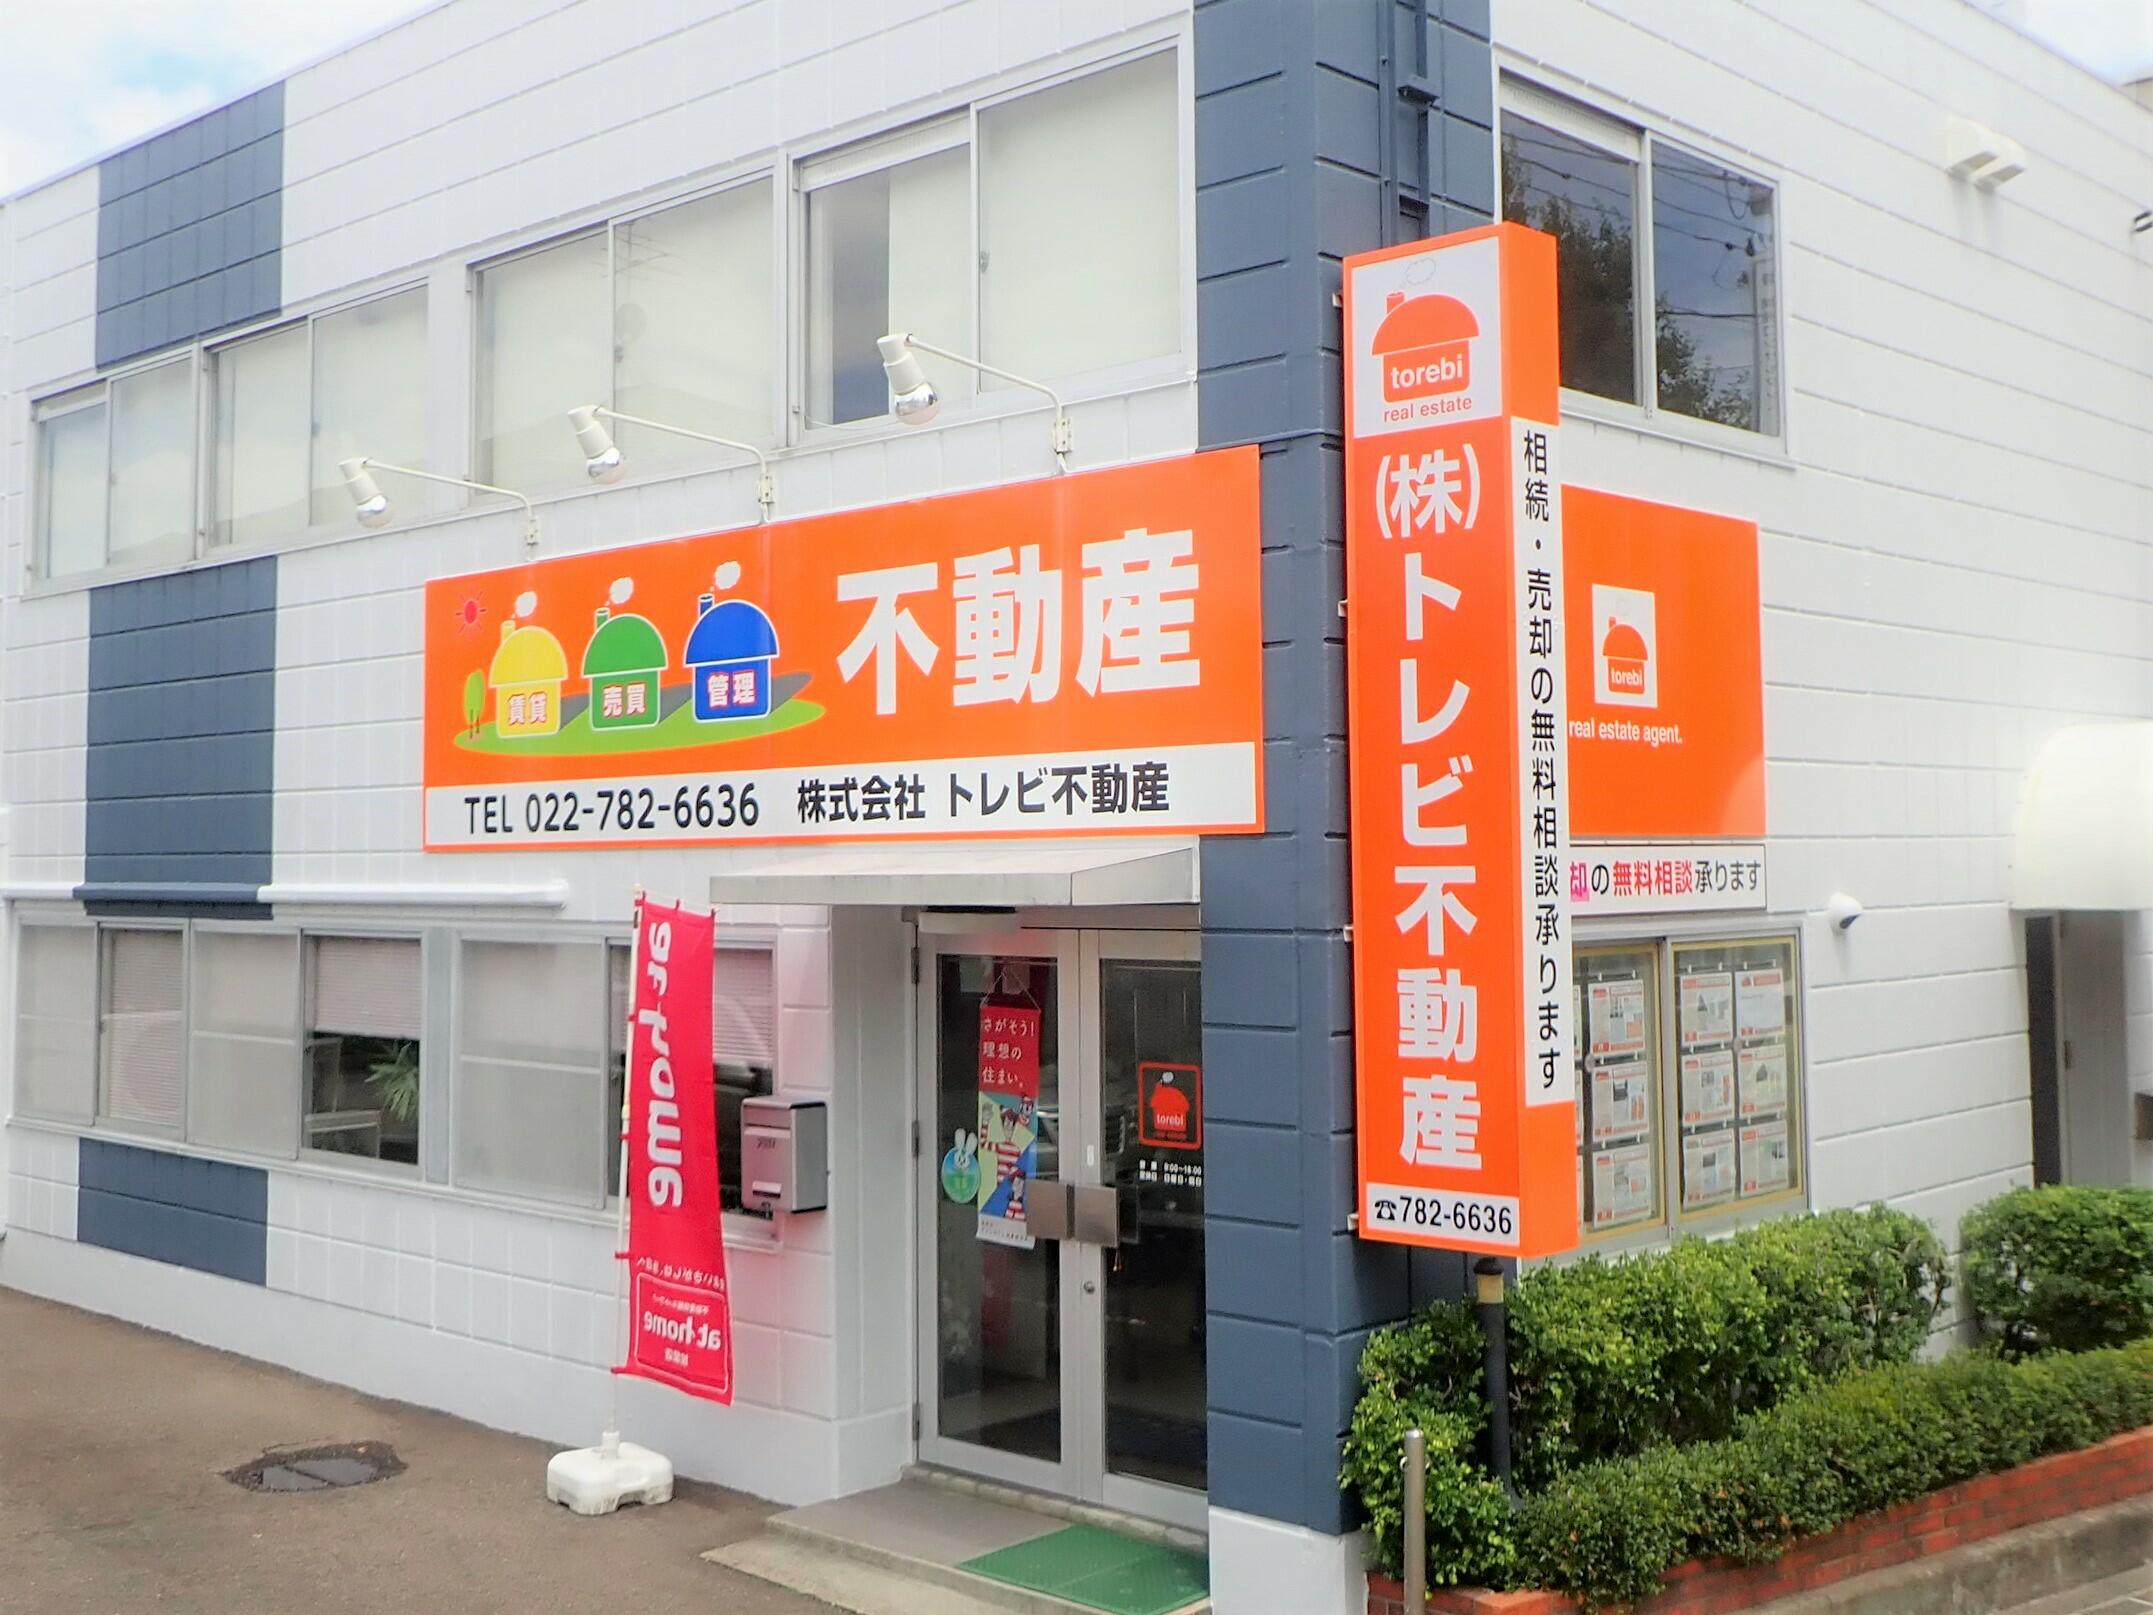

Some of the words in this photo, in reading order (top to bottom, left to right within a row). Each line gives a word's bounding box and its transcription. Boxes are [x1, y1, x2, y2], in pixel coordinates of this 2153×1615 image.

[1390, 354, 1464, 390] torebi
[1383, 403, 1415, 423] real
[1419, 396, 1473, 417] estate
[836, 528, 1201, 716] 不動産
[706, 670, 756, 709] 管理
[1610, 667, 1643, 686] torebi
[506, 691, 548, 726] 賃貸
[601, 681, 647, 718] 売買
[1568, 717, 1595, 738] real
[1599, 719, 1640, 741] estate
[1643, 724, 1683, 748] agent.
[464, 796, 514, 834] TEL
[526, 782, 760, 832] 022-782-6636
[797, 772, 926, 824] 株式会社
[949, 761, 1170, 818] トレビ不動産
[1399, 1196, 1512, 1235] 782-6636
